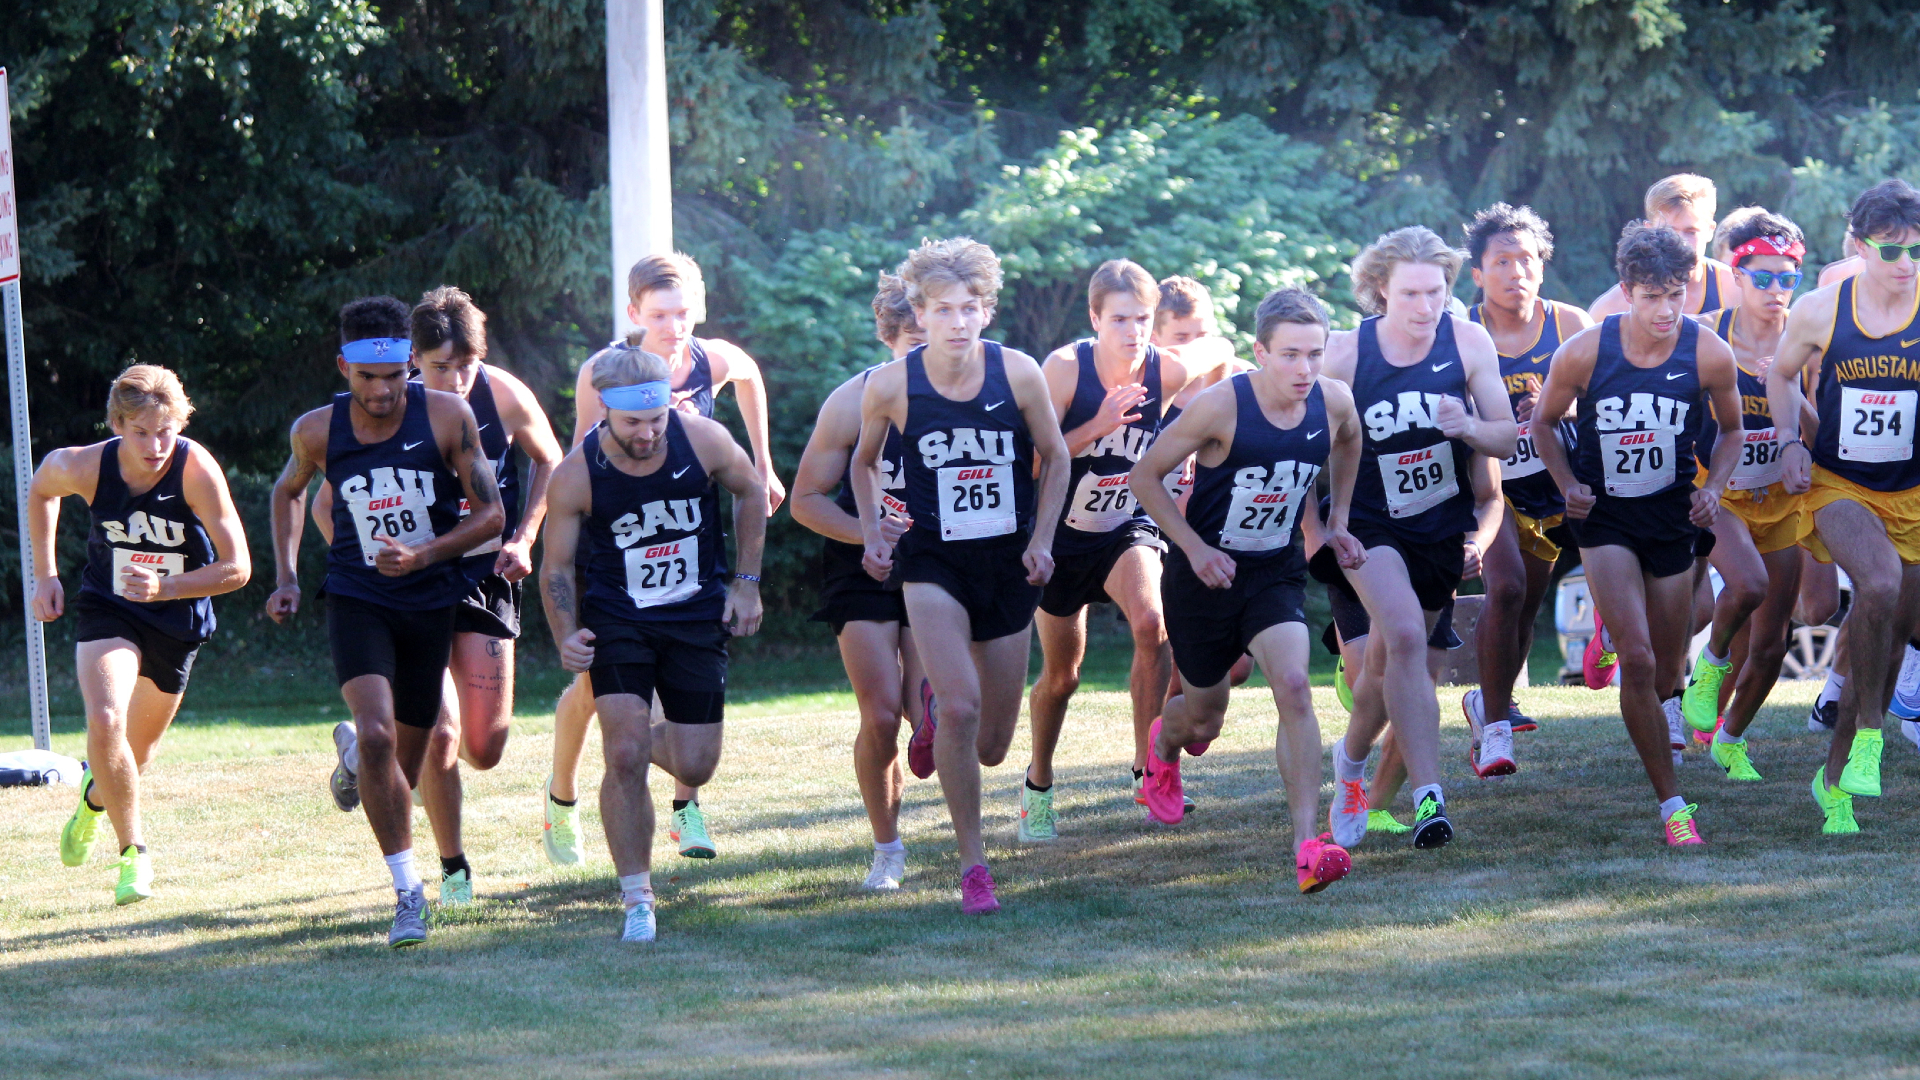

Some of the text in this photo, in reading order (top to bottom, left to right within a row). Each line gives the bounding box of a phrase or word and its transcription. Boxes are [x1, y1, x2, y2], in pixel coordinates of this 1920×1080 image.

[1860, 394, 1897, 405] GILL
[1596, 393, 1690, 435] SAU
[1853, 408, 1901, 436] 254
[918, 428, 1015, 468] SAU
[1620, 433, 1655, 445] GILL
[1398, 449, 1434, 465] GILL
[1615, 447, 1664, 474] 270
[1743, 441, 1778, 466] 387
[340, 467, 436, 507] SAU
[957, 468, 994, 481] GILL
[1097, 476, 1128, 487] GILL
[1395, 463, 1443, 494] 269
[368, 496, 404, 511] GILL
[952, 482, 1000, 512] 265
[1084, 488, 1129, 512] 276
[1253, 493, 1289, 503] GILL
[101, 511, 186, 547] SAU
[366, 509, 417, 540] 268
[611, 497, 702, 549] SAU
[1239, 506, 1289, 530] 274
[131, 553, 165, 564] GILL
[645, 543, 680, 559] GILL
[640, 558, 687, 588] 273
